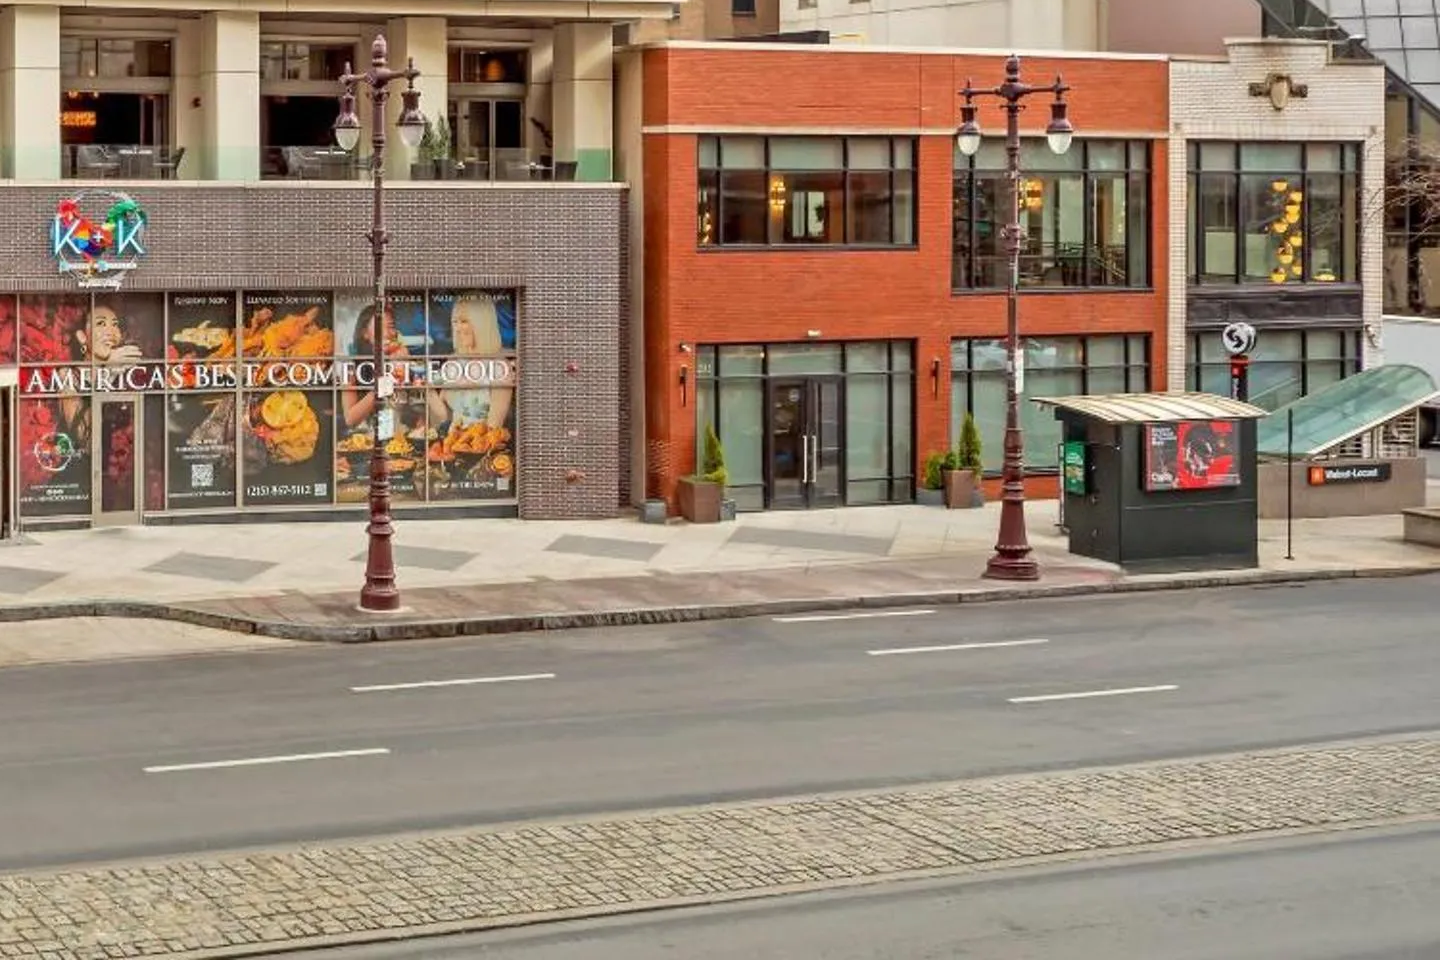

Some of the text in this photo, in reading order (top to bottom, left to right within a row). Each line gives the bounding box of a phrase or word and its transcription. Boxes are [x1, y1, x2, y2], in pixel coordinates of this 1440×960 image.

[27, 359, 509, 393] AMERICA'S BEST COMFORT FOOD
